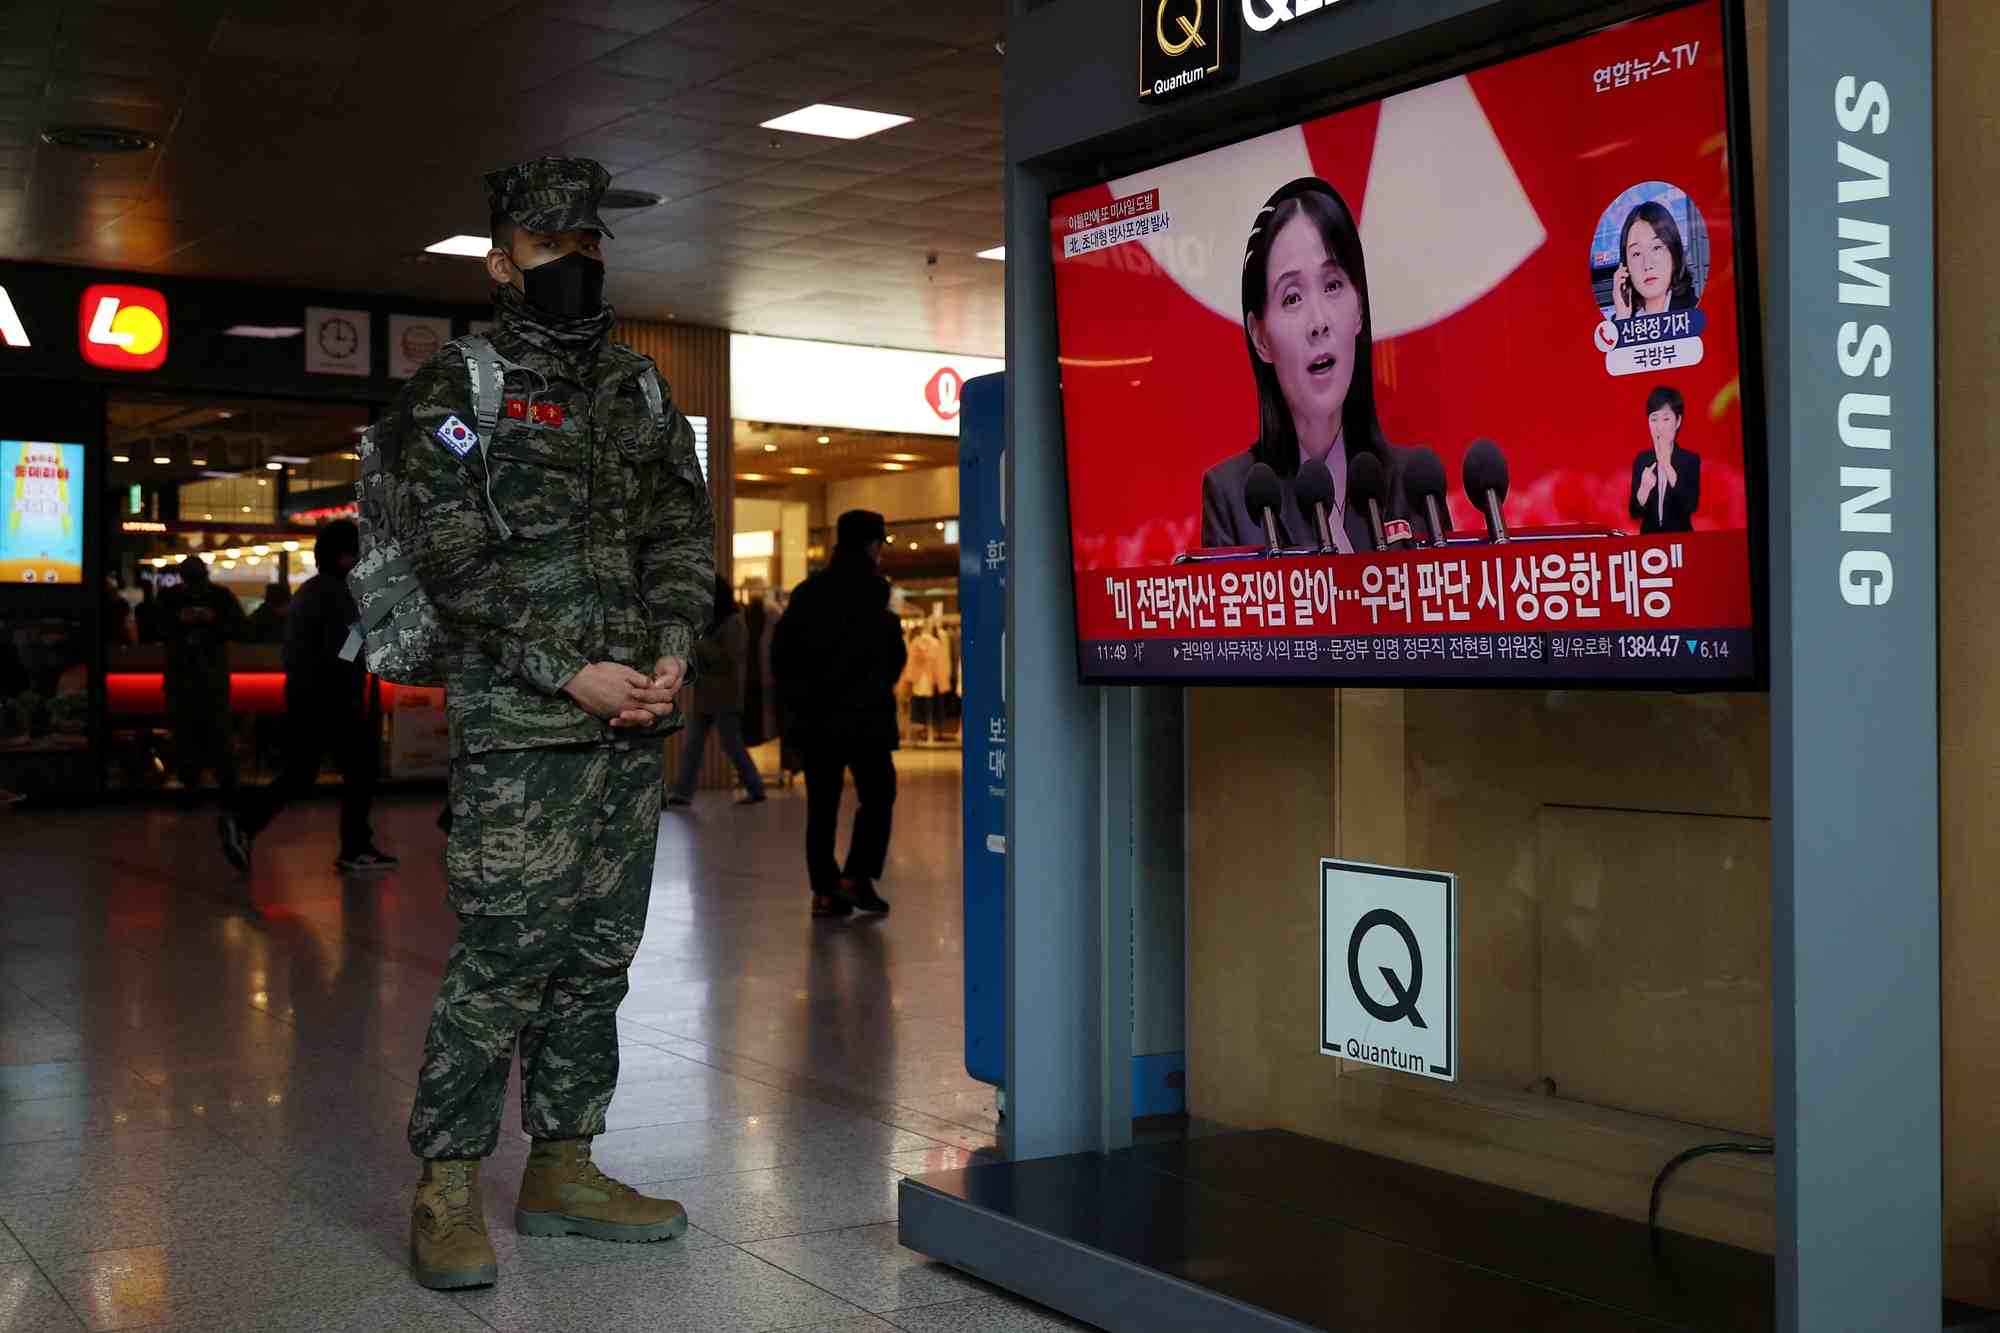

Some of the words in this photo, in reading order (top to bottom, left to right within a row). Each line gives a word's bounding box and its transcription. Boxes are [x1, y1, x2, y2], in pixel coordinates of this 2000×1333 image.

[1153, 66, 1204, 95] Quantum
[1593, 40, 1700, 93] 연합뉴스TV
[1151, 210, 1169, 232] 발사
[1622, 317, 1661, 344] 신현정
[1663, 311, 1691, 337] 기자
[1834, 75, 1894, 606] SAMSUNG
[1633, 345, 1678, 368] 국방부
[1106, 577, 1133, 631] "미
[1136, 573, 1216, 630] 전략자산
[1219, 569, 1287, 628] 움직임
[1416, 560, 1471, 622] 판단
[1477, 557, 1505, 621] 시
[1510, 551, 1602, 622] 상응한
[1608, 543, 1683, 619] 대응"
[1097, 643, 1127, 661] 11:49
[1181, 641, 1215, 661] 권익위
[1217, 640, 1264, 661] 사무처장
[1265, 639, 1291, 661] 사의
[1372, 638, 1400, 660] 임명
[1403, 637, 1446, 660] 정무직
[1449, 636, 1493, 660] 전현희
[1497, 635, 1543, 660] 위원장
[1552, 636, 1614, 658] 원/유로화
[1618, 635, 1680, 658] 1384.47
[1700, 640, 1729, 660] 6.14
[1348, 909, 1428, 1029] Q
[1346, 1038, 1424, 1073] Quantum
